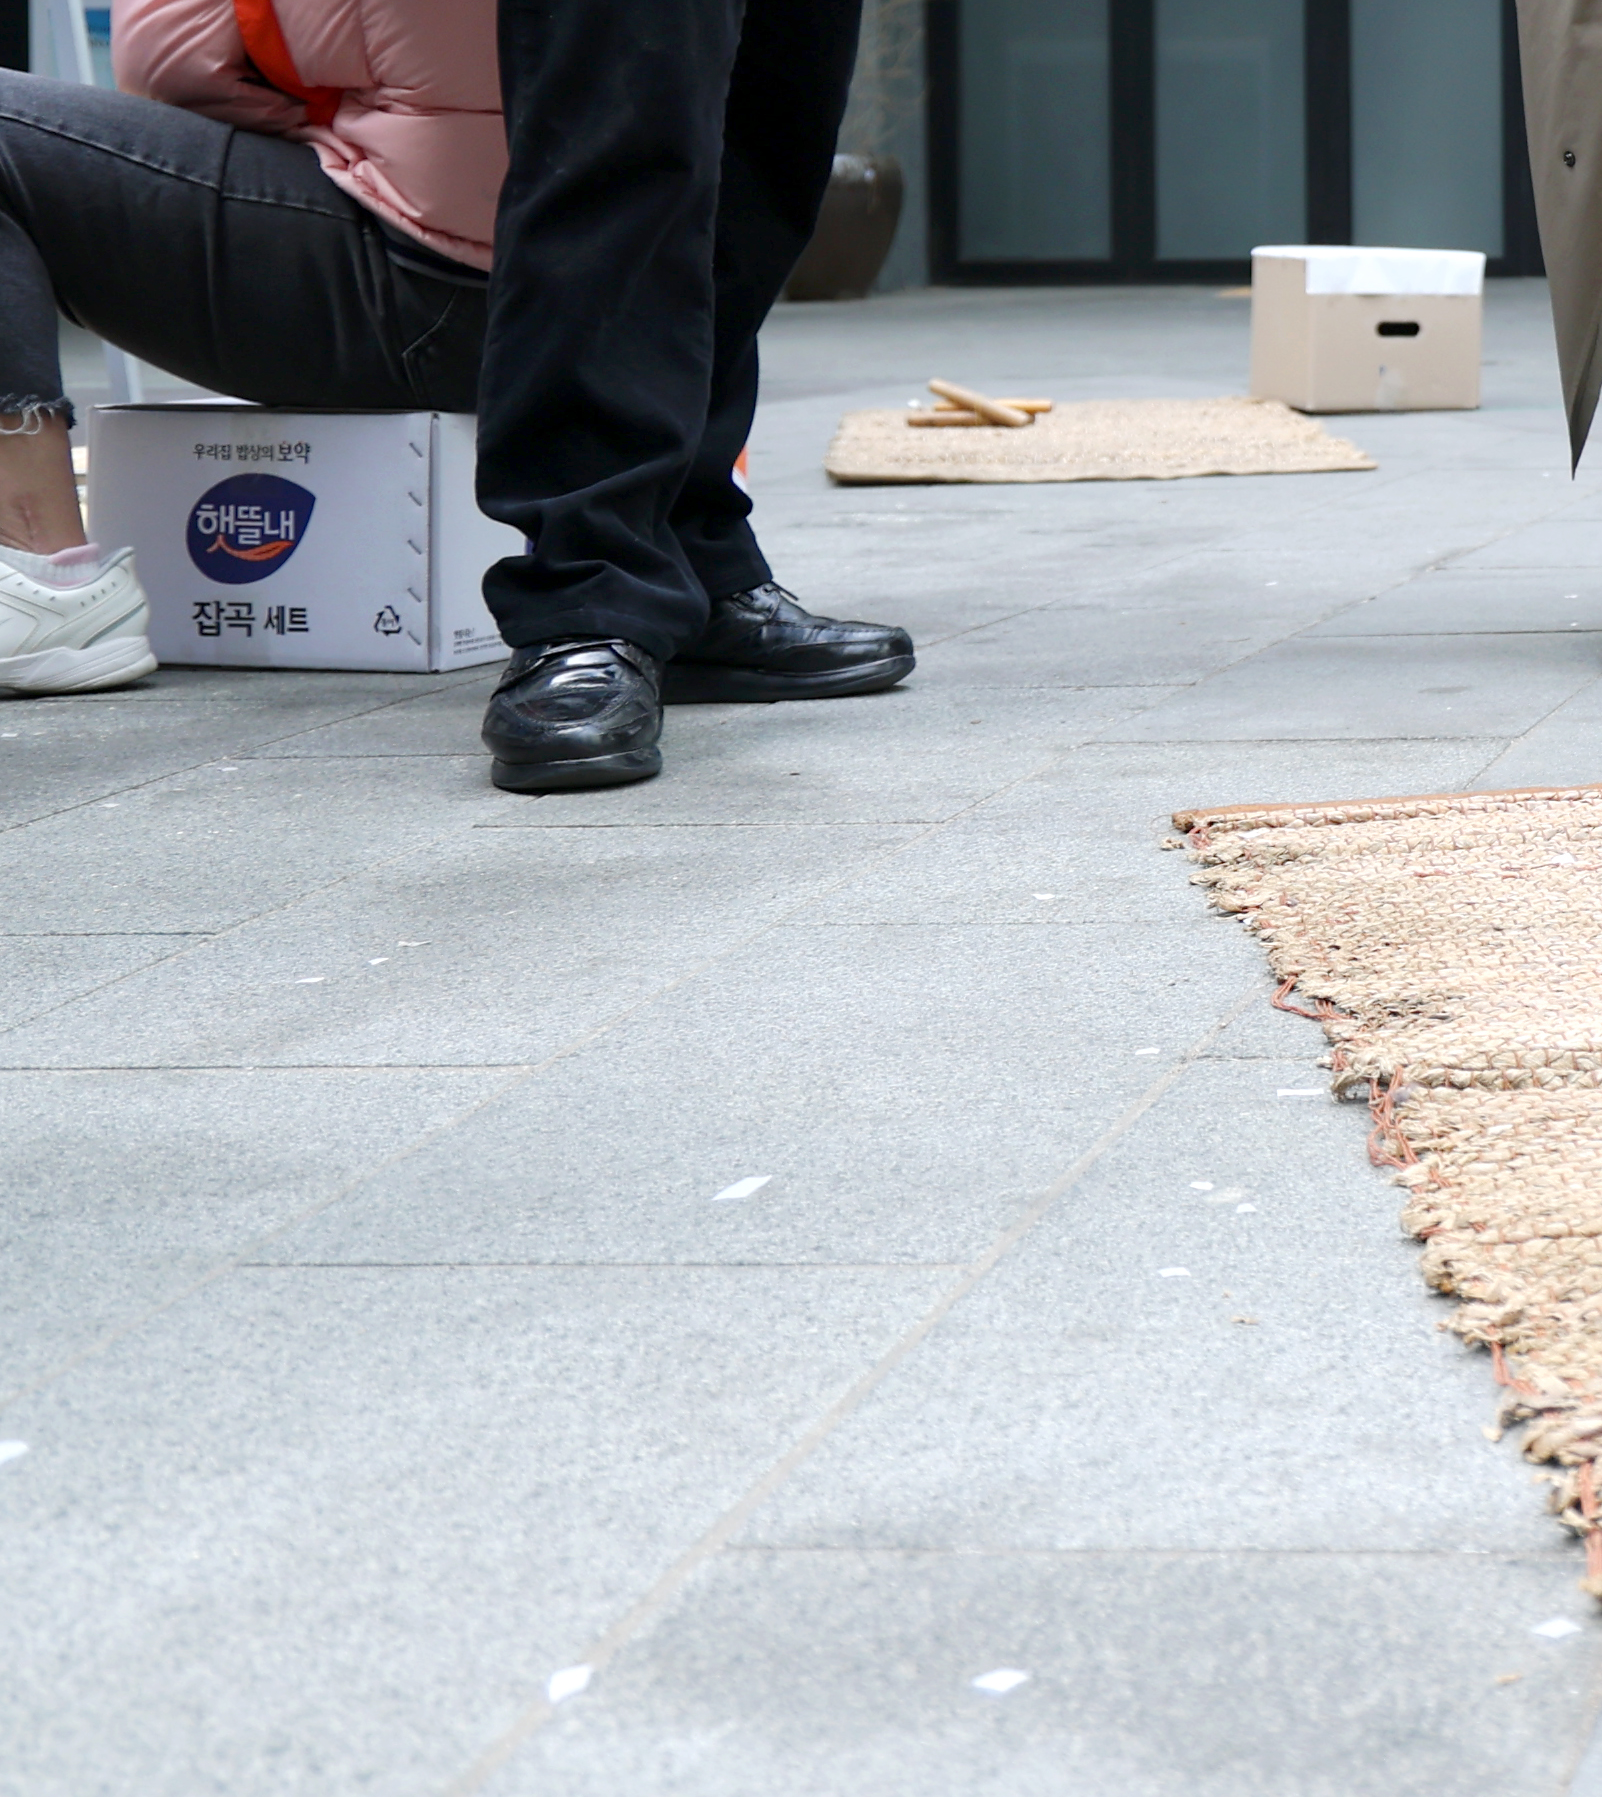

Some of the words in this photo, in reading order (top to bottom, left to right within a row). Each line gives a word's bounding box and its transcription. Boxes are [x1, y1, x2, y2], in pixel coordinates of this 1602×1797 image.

[193, 443, 232, 461] 우리집
[235, 443, 275, 462] 밥상의
[277, 441, 311, 465] 보약
[192, 600, 256, 637] 잡곡
[264, 605, 310, 636] 세트
